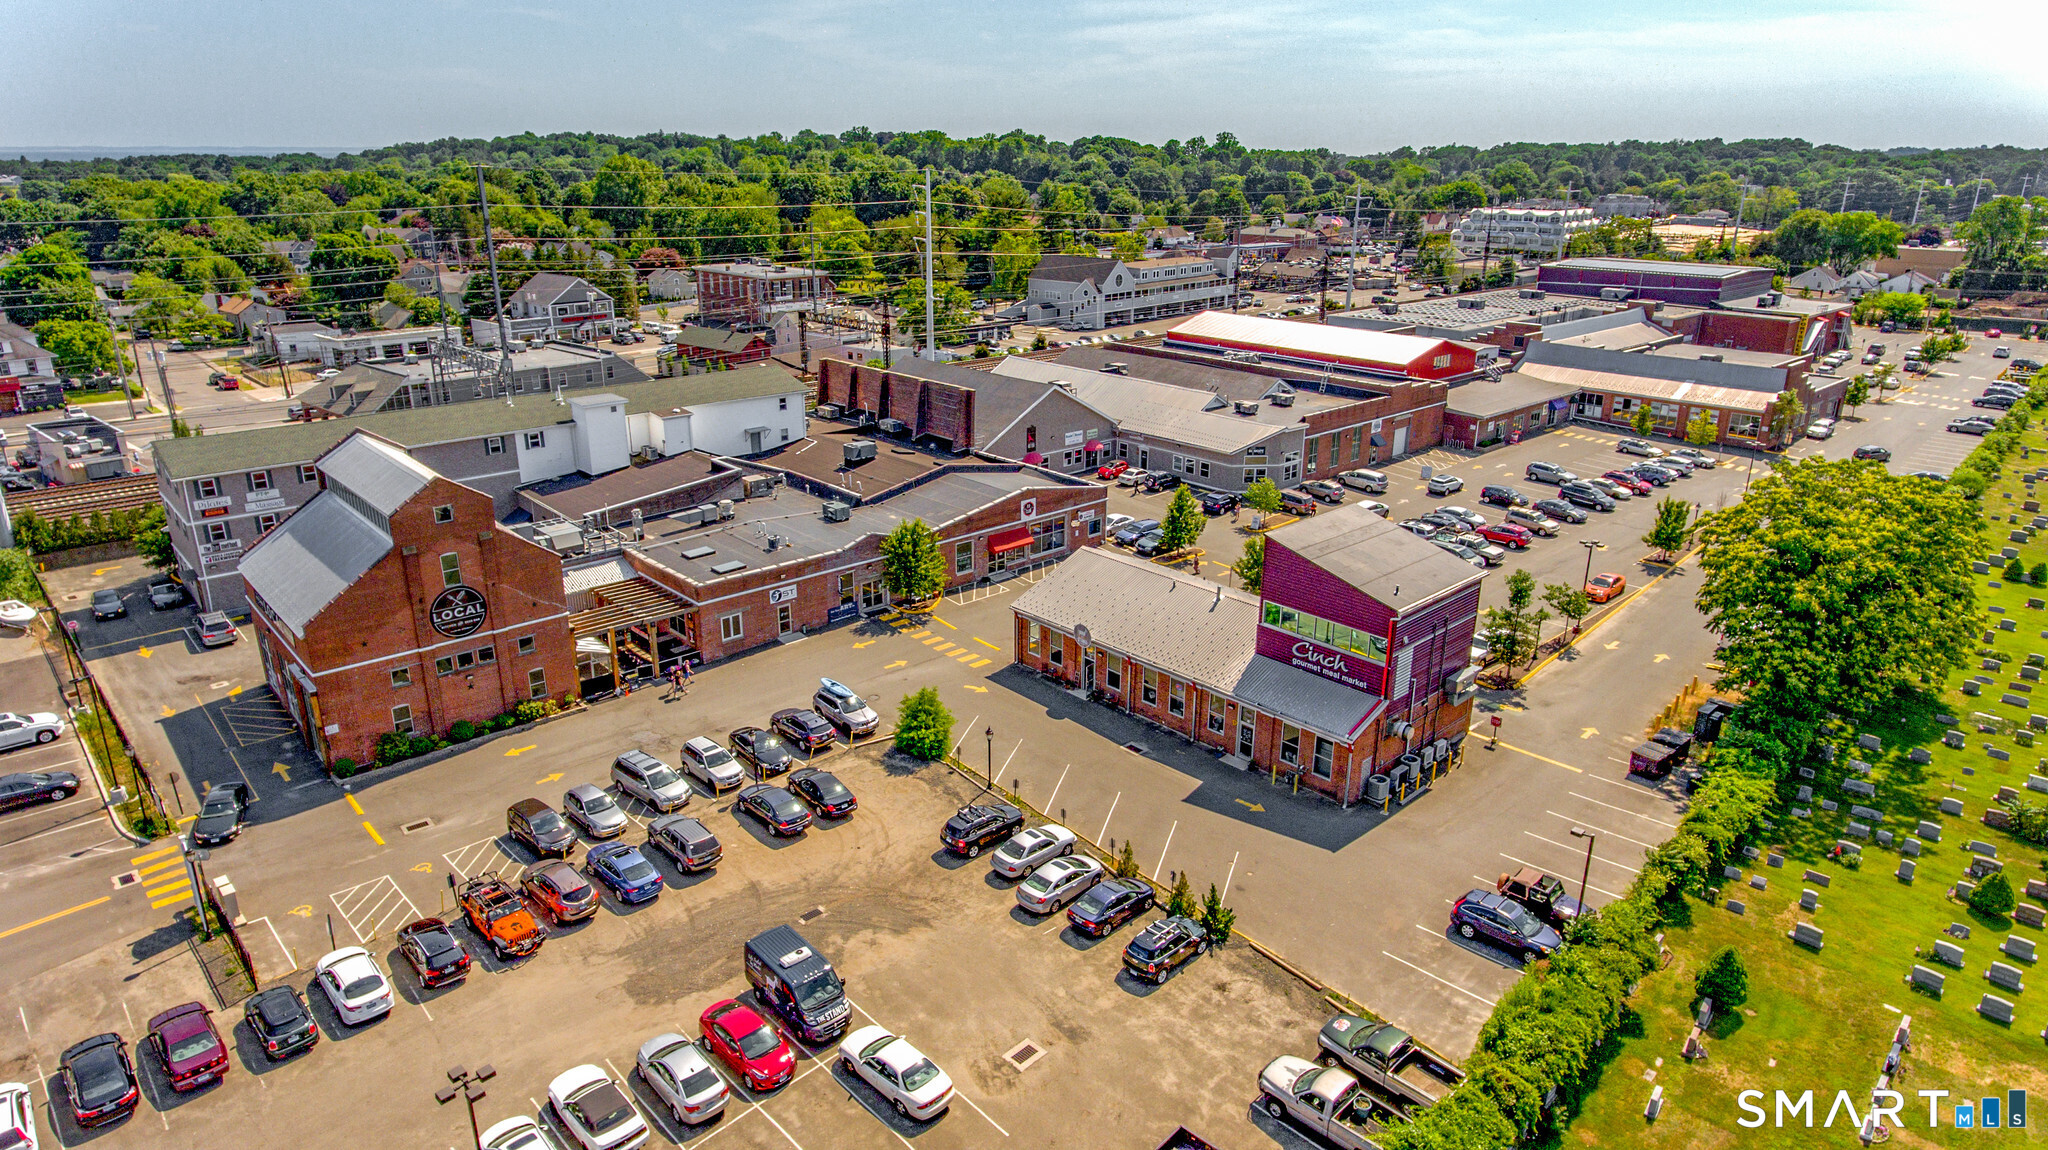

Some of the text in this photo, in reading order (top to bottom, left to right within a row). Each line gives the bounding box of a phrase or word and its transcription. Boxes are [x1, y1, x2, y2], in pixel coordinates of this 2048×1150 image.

[198, 499, 229, 509] Pilates
[432, 603, 485, 622] LOCAL
[1292, 642, 1348, 672] Cinch
[1292, 658, 1367, 689] gourmet meal market
[816, 1004, 846, 1023] THE STAND
